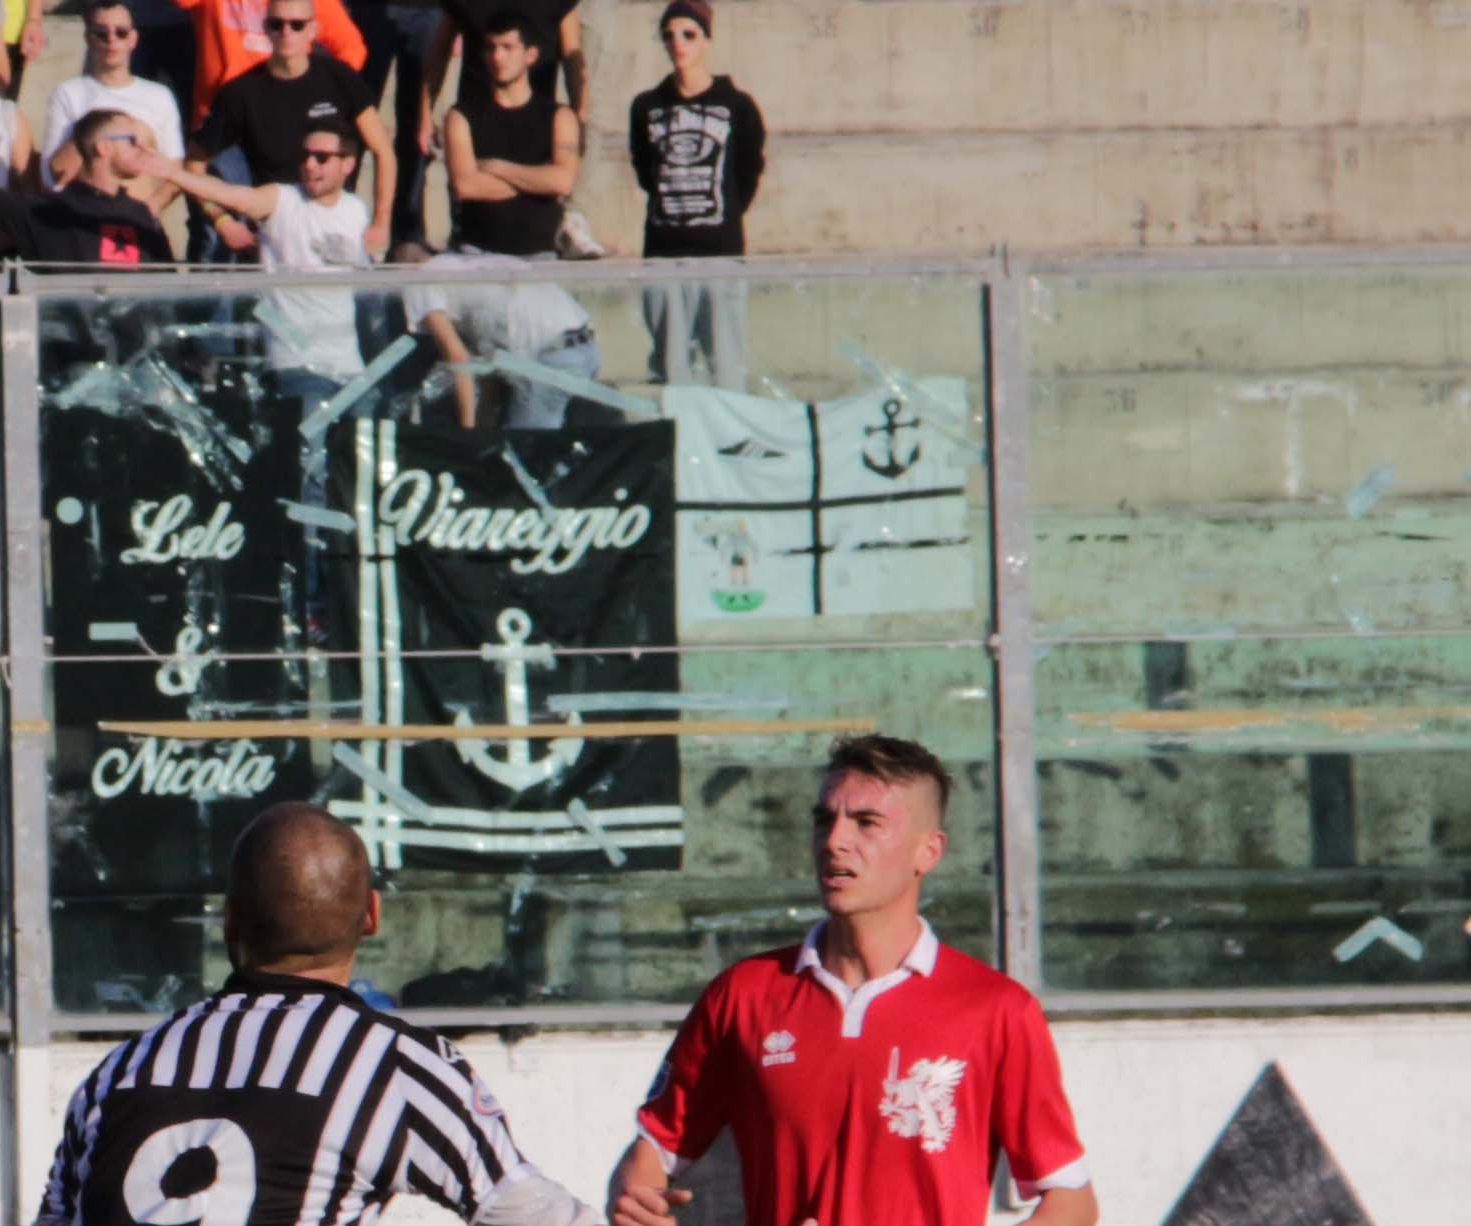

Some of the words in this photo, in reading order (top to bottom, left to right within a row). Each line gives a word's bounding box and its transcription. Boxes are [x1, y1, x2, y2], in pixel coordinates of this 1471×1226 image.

[119, 494, 246, 562] Lele
[379, 469, 651, 575] Viareggio
[91, 737, 276, 799] Nicola
